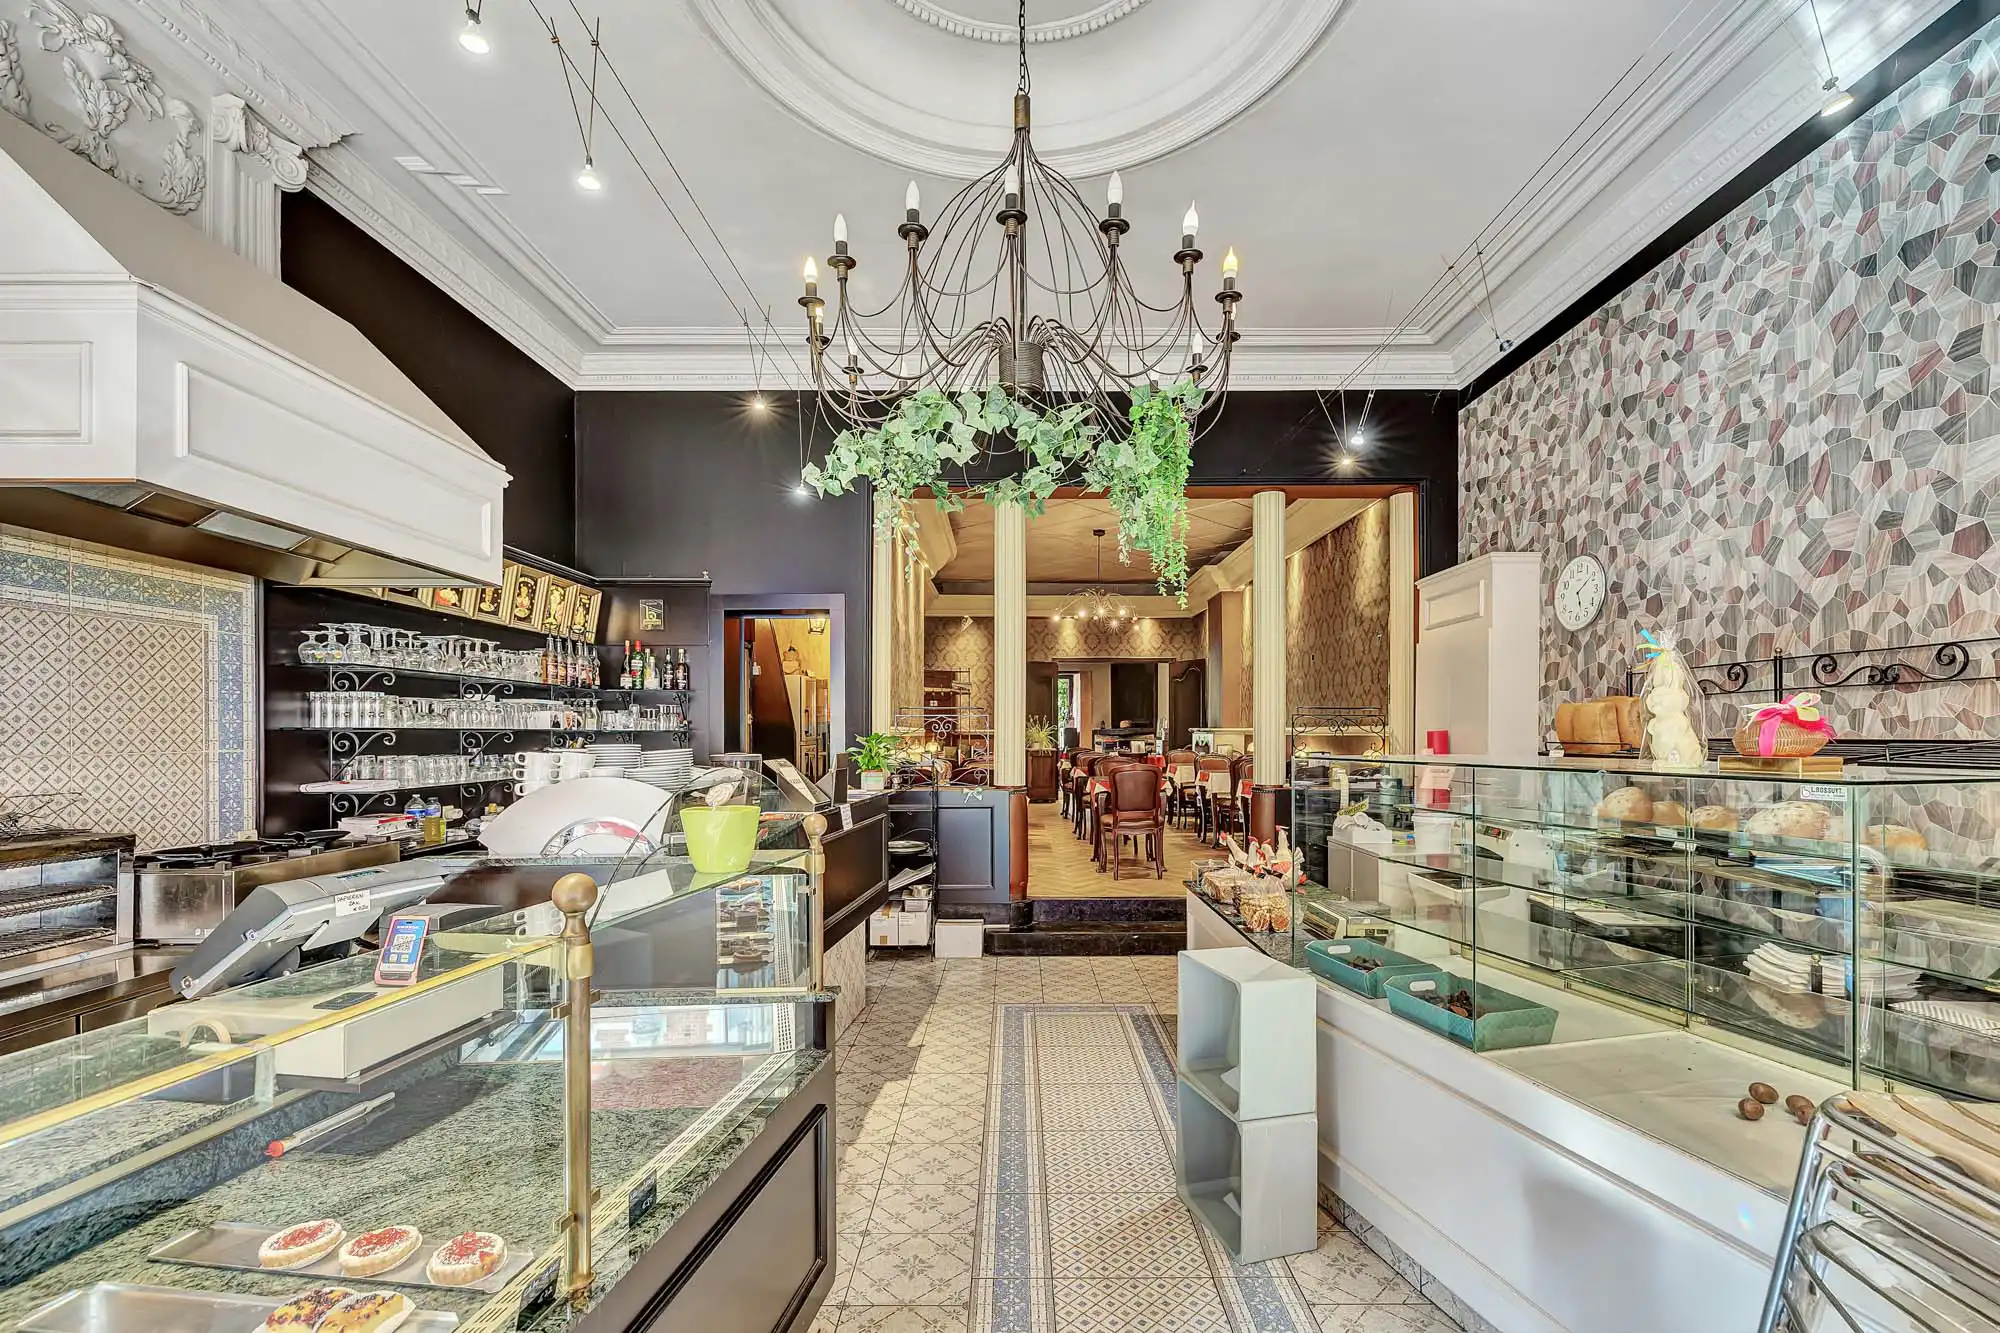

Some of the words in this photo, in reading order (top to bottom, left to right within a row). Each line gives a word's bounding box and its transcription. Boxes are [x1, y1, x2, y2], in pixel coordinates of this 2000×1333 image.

[1562, 581, 1569, 590] 10
[1594, 584, 1599, 593] 3
[1575, 612, 1580, 621] 6
[1584, 607, 1588, 617] 5
